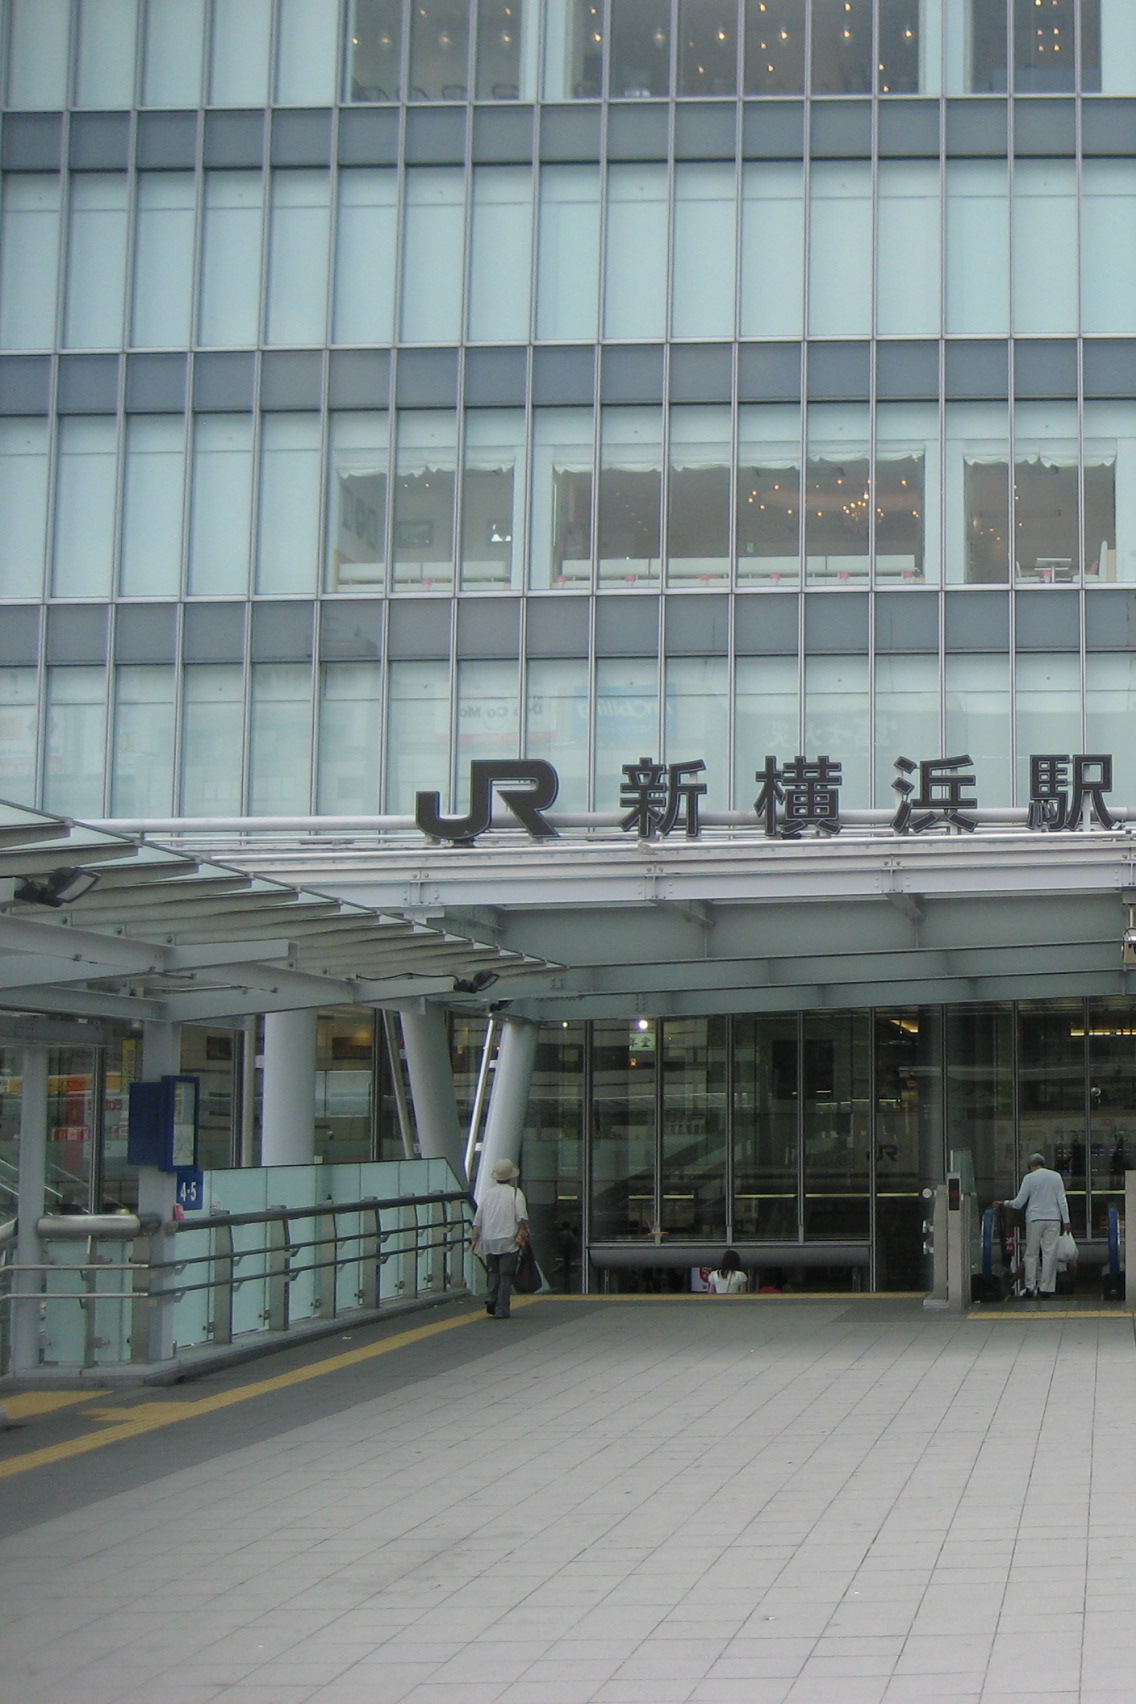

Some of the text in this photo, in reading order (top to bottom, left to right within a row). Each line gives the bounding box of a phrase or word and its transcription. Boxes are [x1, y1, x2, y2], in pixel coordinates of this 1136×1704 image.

[416, 759, 559, 839] JR
[620, 754, 1118, 837] 新横浜駅
